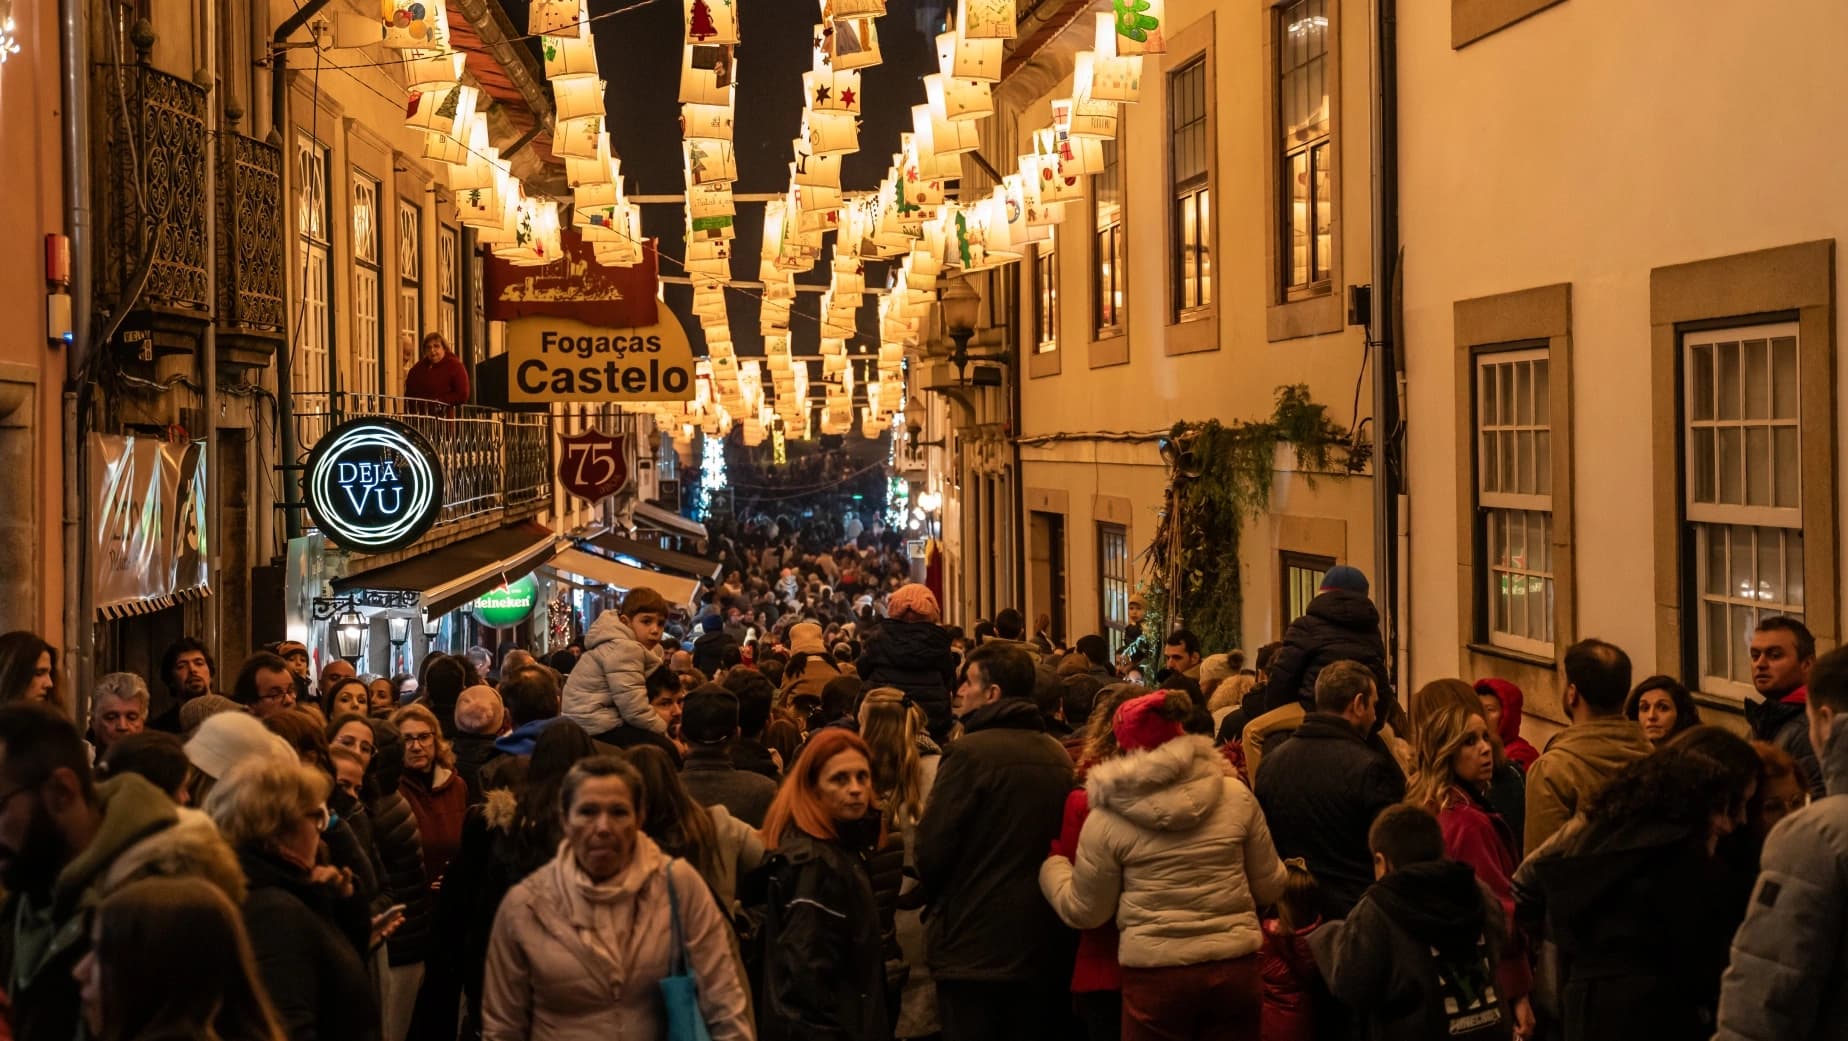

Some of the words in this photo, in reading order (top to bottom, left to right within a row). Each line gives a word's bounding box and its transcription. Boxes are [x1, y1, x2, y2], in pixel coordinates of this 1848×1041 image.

[541, 331, 661, 359] Fogaças
[516, 358, 689, 394] Castelo
[568, 440, 615, 485] 75
[341, 484, 404, 516] VU
